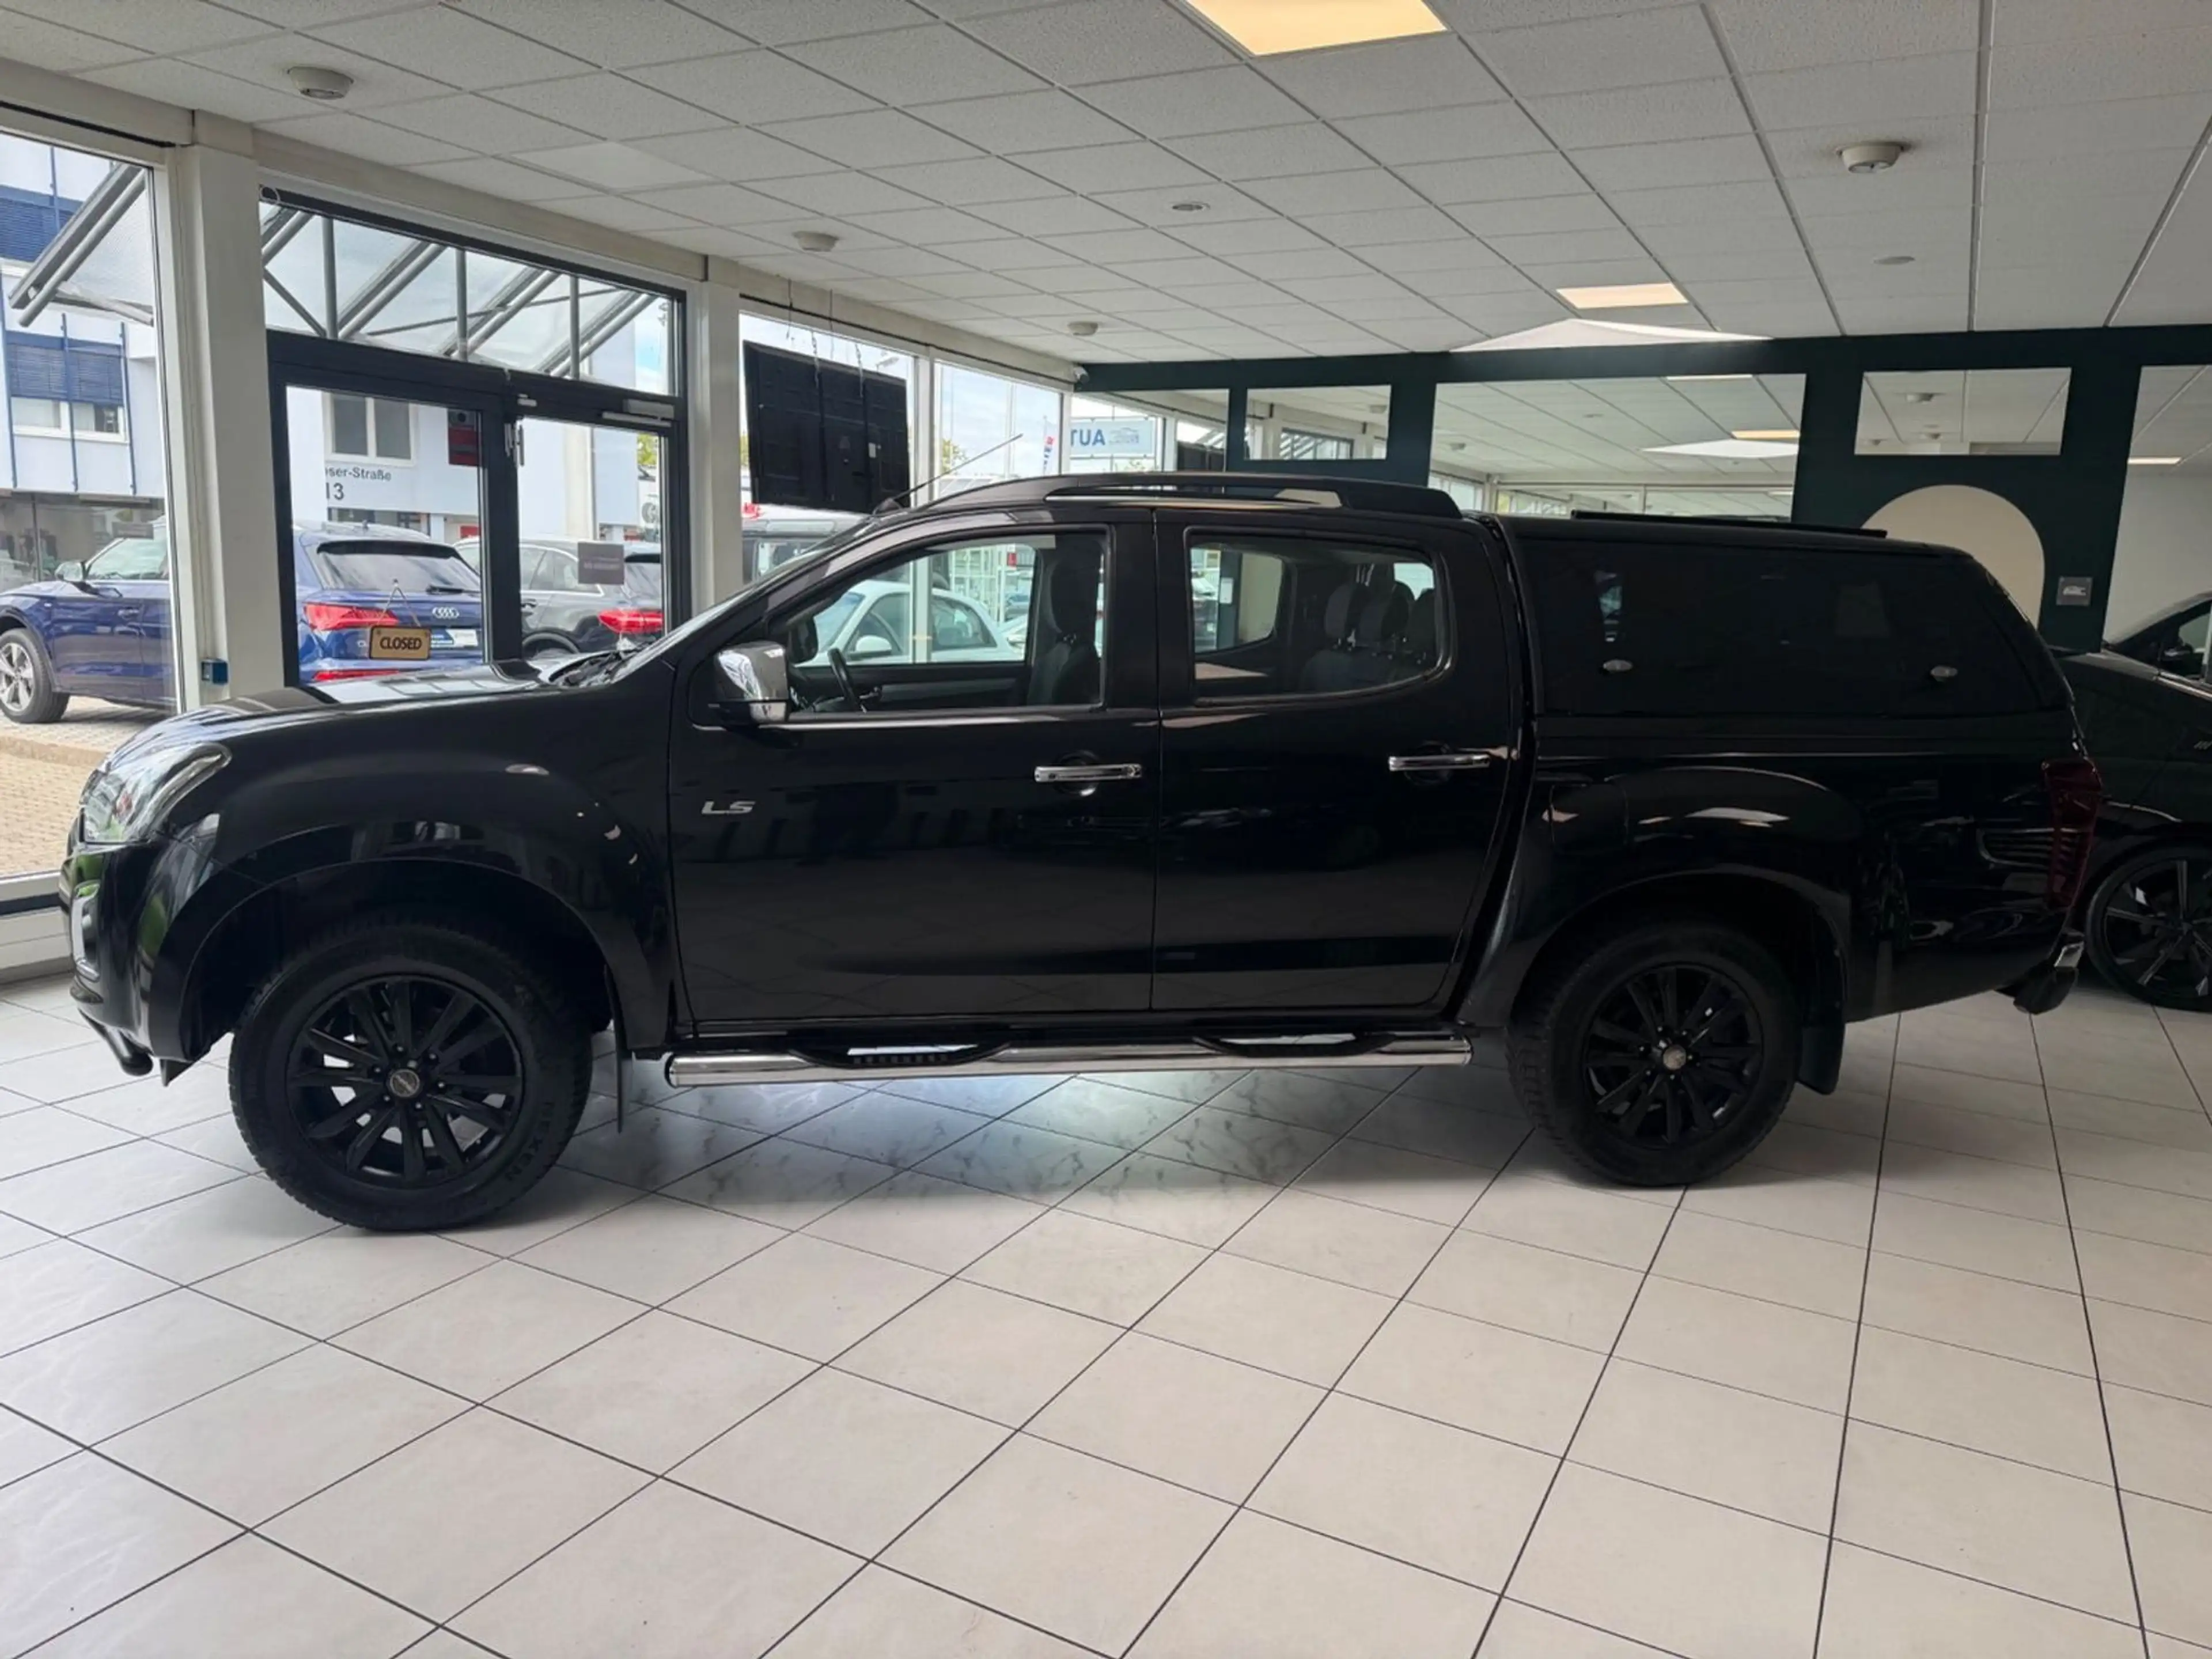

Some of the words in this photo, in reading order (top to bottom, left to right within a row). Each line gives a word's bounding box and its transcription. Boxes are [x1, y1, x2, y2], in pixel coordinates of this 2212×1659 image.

[325, 465, 392, 482] ser-Straße
[380, 636, 422, 650] CLOSED
[702, 801, 756, 815] LS
